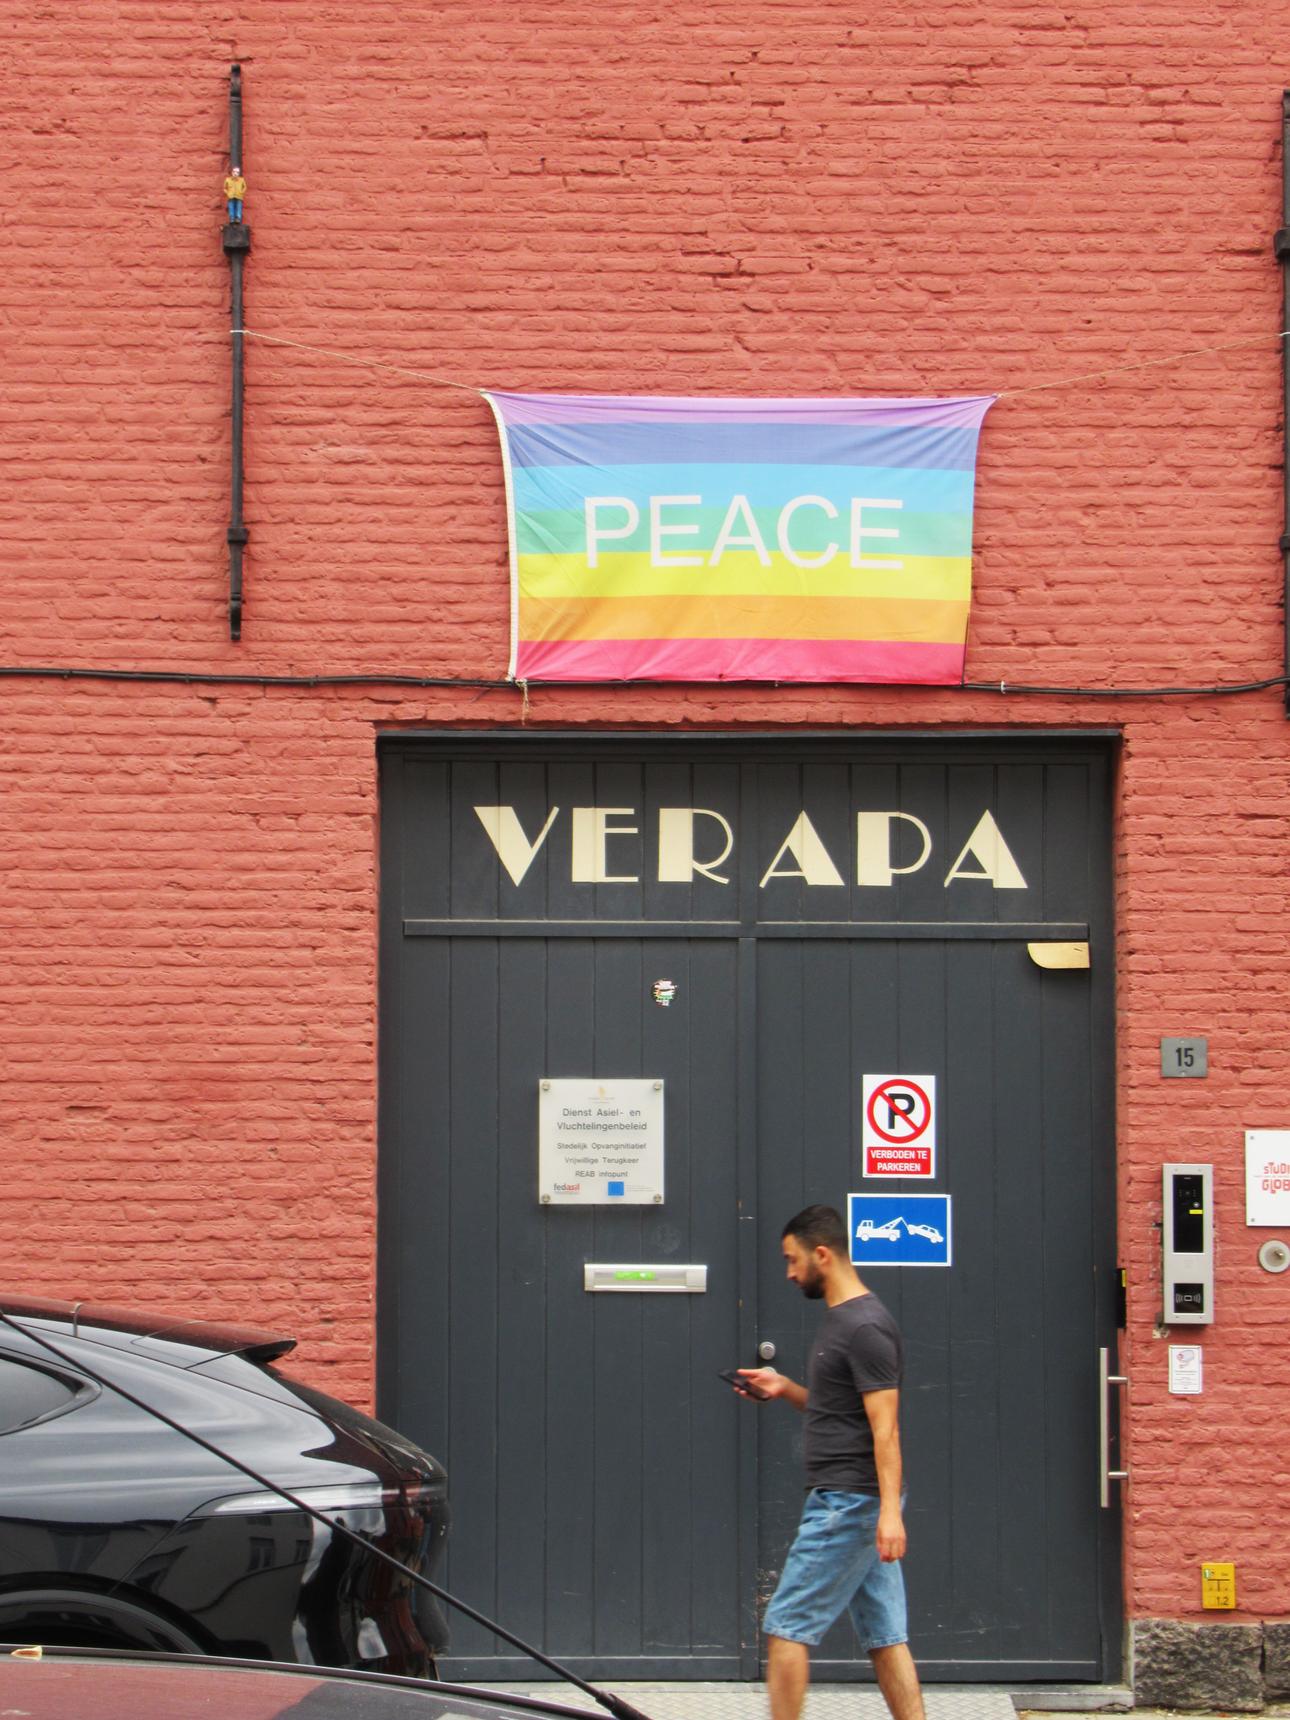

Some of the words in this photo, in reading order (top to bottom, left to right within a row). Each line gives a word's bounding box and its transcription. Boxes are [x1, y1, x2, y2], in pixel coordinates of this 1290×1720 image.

[584, 494, 905, 570] PEACE
[473, 806, 1028, 889] VERAPA
[1175, 1047, 1194, 1067] 15
[562, 1108, 592, 1117] Dienst
[629, 1109, 641, 1117] en
[887, 1093, 915, 1129] P
[557, 1122, 647, 1131] Vluchtelingenbeleid
[557, 1142, 588, 1150] Stedelijk
[591, 1142, 647, 1150] Opvanginitiatief
[870, 1150, 915, 1159] VERBODEN
[917, 1150, 927, 1159] TE
[565, 1157, 599, 1165] Vrijwillige
[602, 1157, 639, 1165] Terugkeer
[877, 1162, 921, 1172] PARKEREN
[553, 1183, 580, 1191] fedasil
